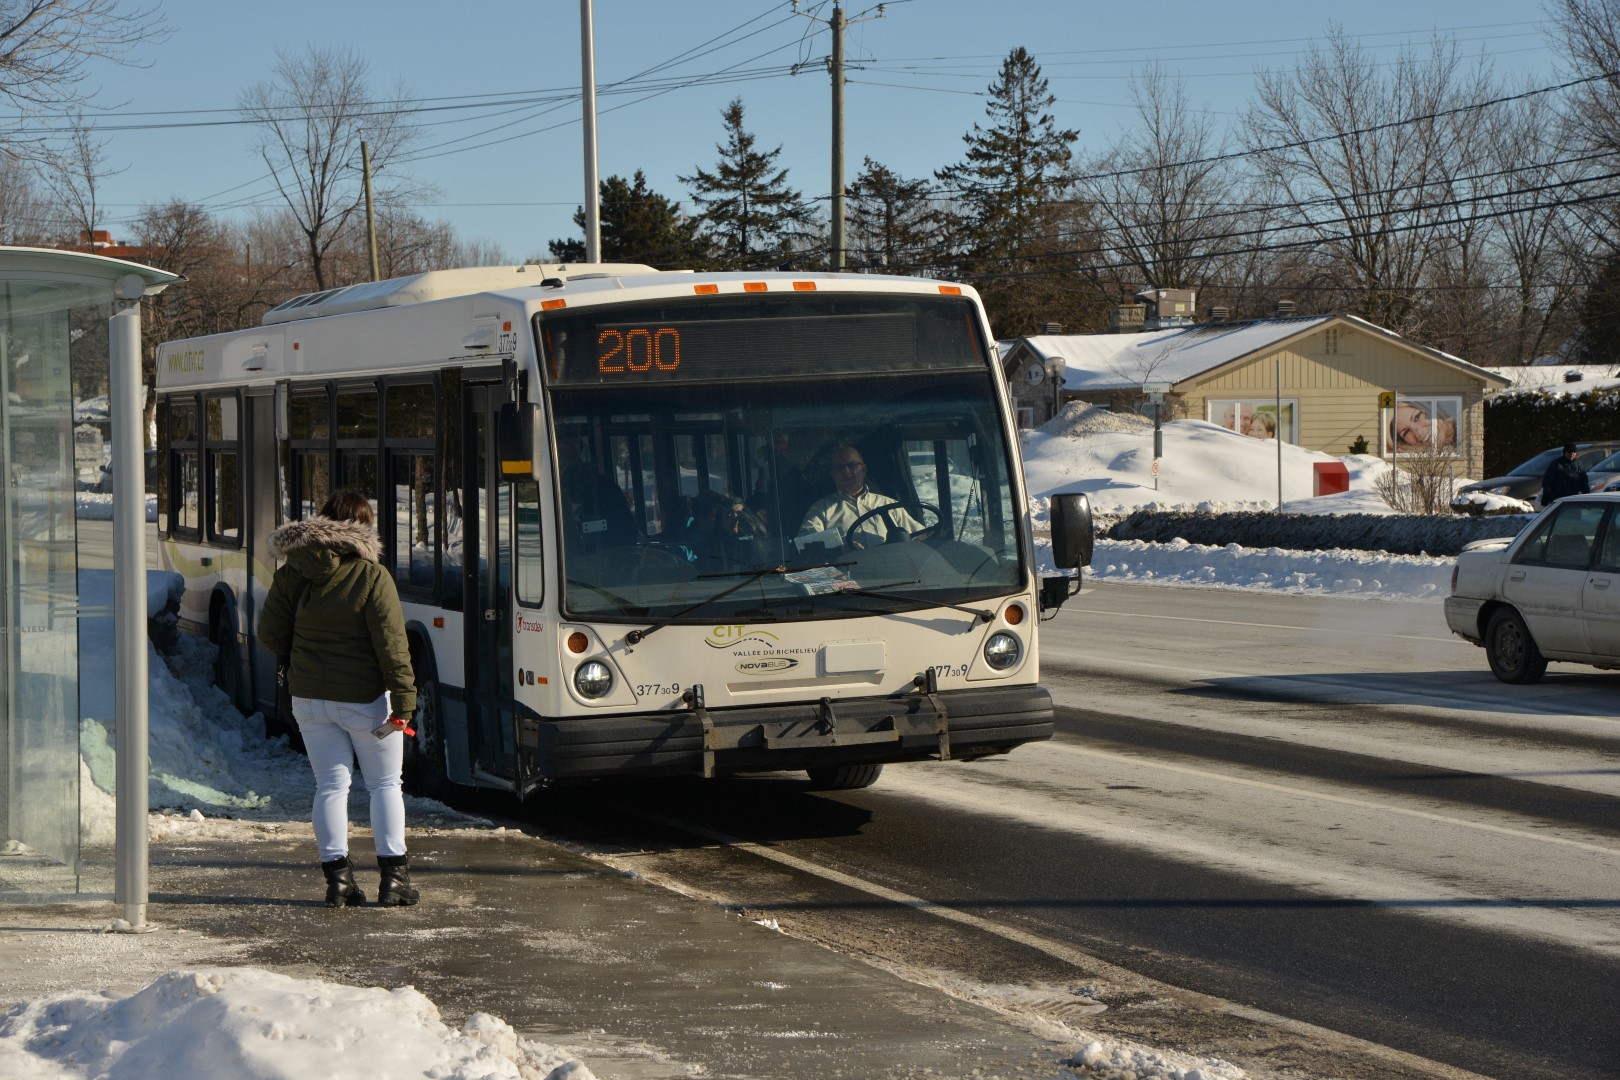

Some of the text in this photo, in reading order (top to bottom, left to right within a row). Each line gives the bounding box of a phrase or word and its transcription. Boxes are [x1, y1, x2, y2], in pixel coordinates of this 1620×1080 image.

[598, 327, 680, 372] 200
[523, 620, 544, 632] transdev
[712, 625, 745, 638] CIT
[763, 648, 775, 656] DU
[776, 647, 817, 655] RICHELIEU
[928, 663, 968, 678] 77309
[636, 682, 680, 696] 377309
